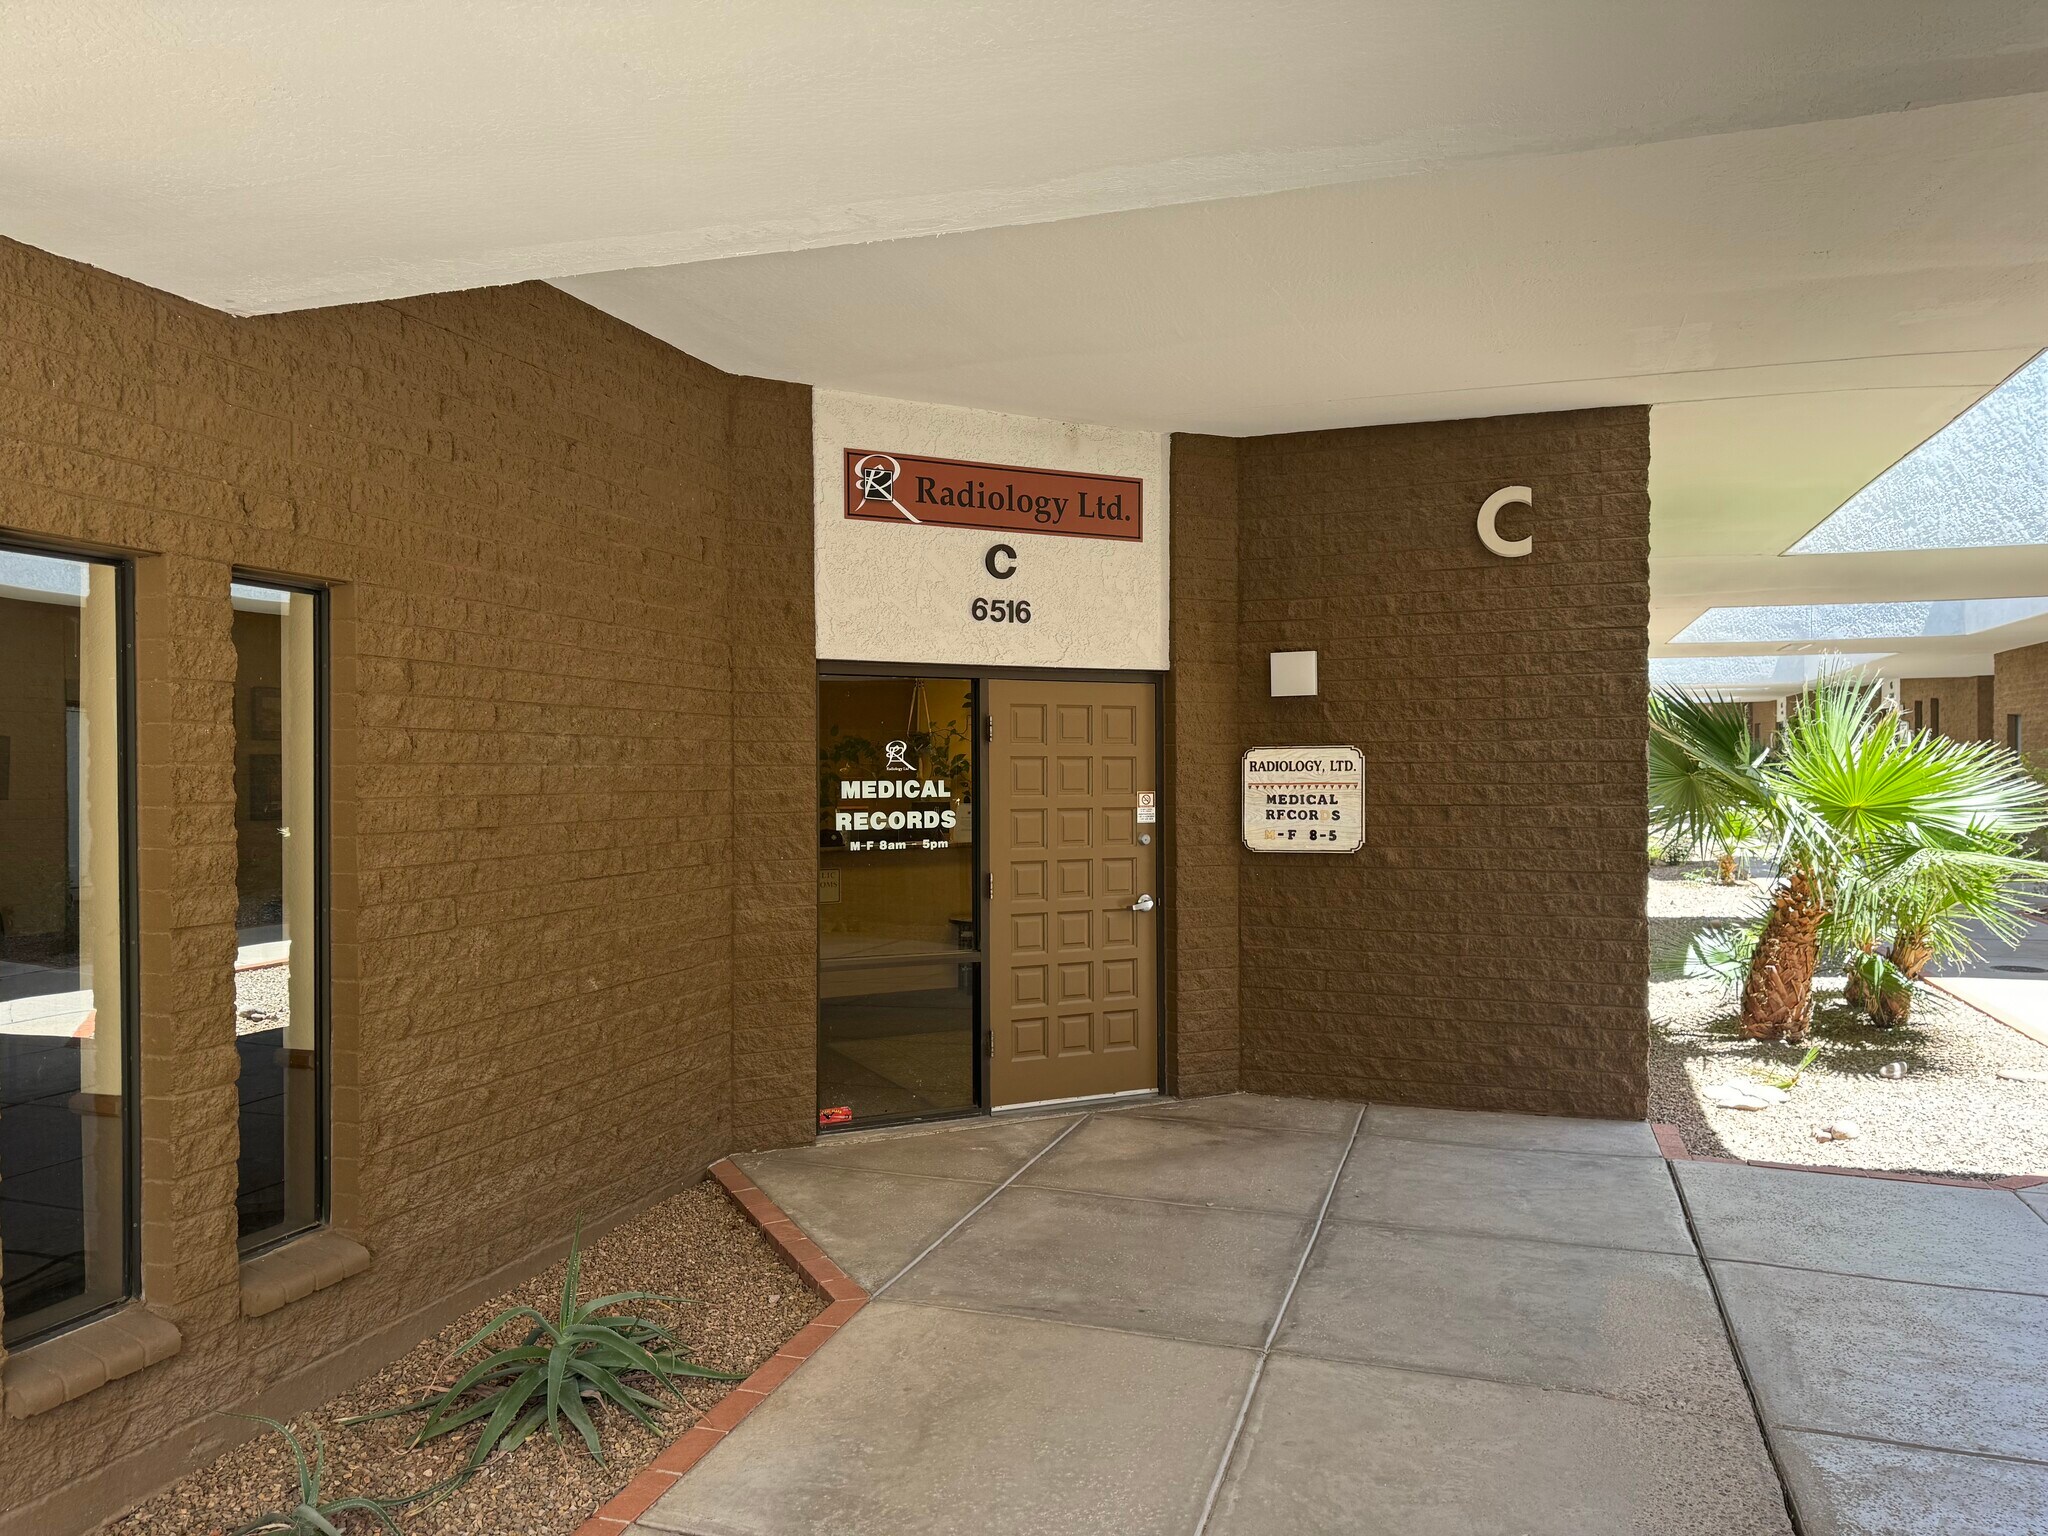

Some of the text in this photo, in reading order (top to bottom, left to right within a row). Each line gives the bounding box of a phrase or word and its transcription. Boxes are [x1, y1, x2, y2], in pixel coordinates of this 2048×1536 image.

[915, 476, 1131, 524] Radiology Ltd.
[1477, 486, 1532, 557] C
[985, 544, 1017, 579] C
[971, 598, 1031, 624] 6516
[1249, 761, 1357, 773] RADIOLOGY, LTD.
[841, 780, 951, 799] MEDICAL
[1266, 794, 1339, 805] MEDICAL
[835, 810, 957, 831] RECORDS
[850, 841, 874, 851] M-F
[879, 840, 906, 850] 8am
[922, 839, 949, 850] 5pm
